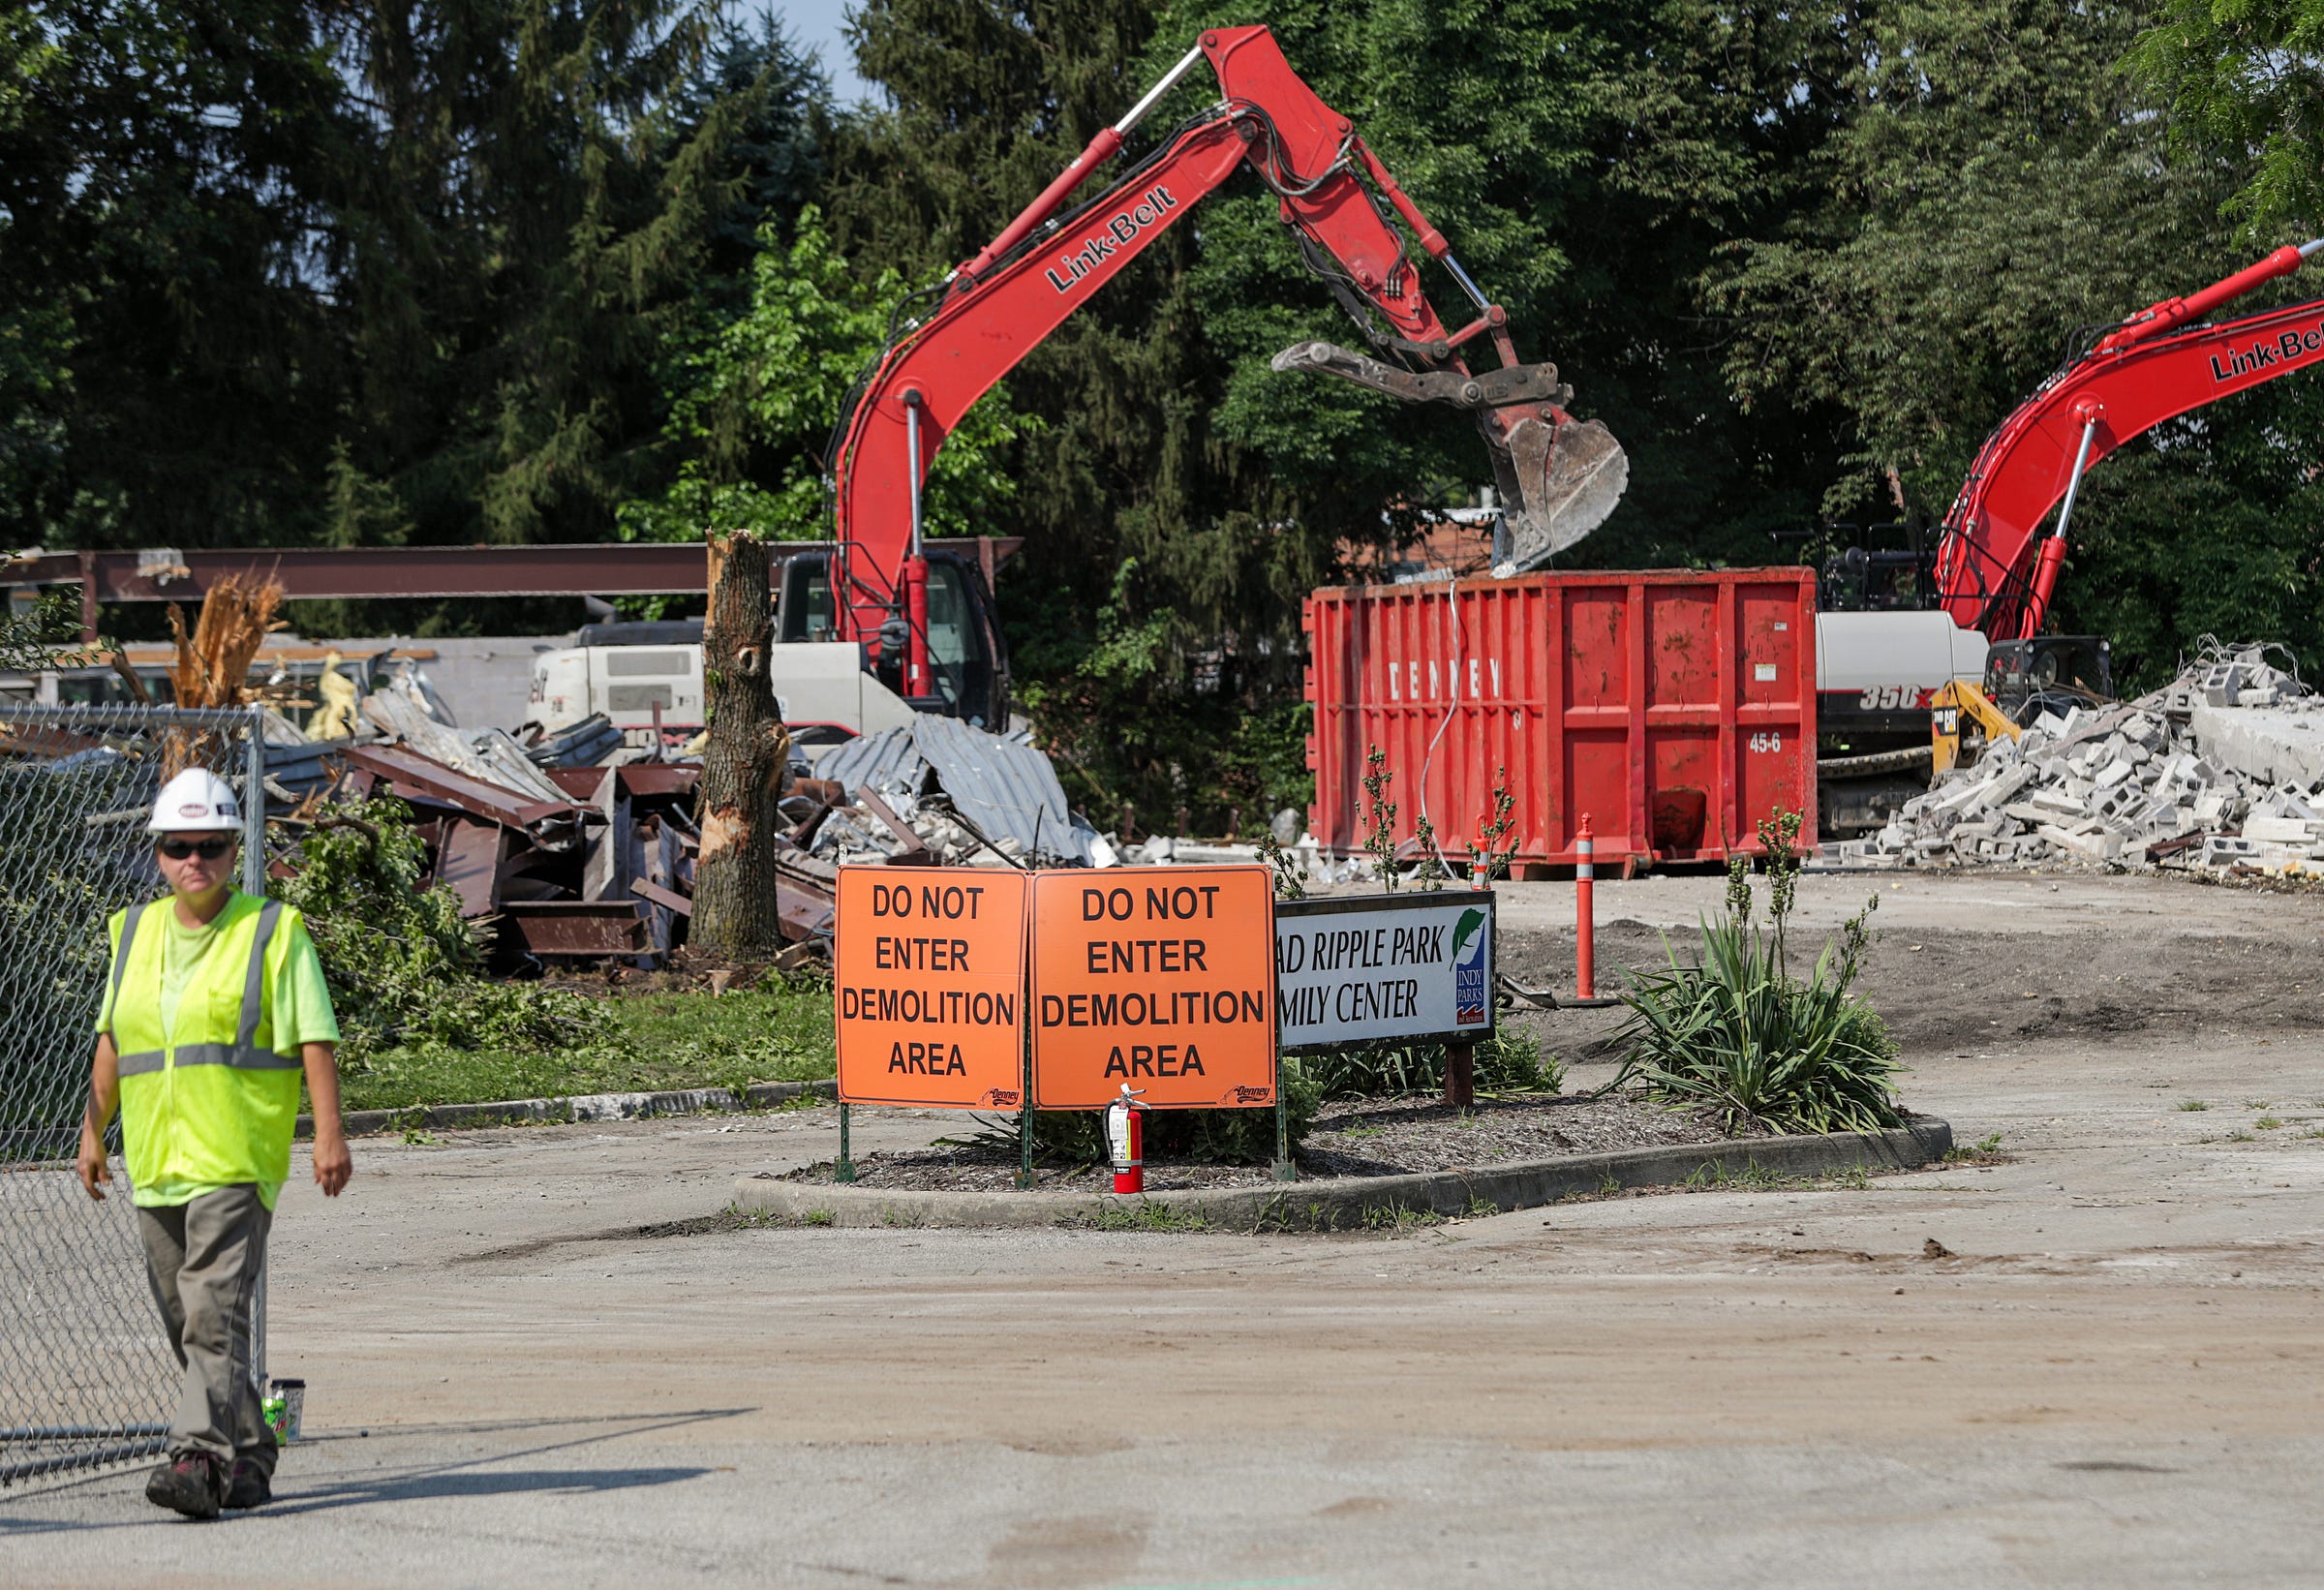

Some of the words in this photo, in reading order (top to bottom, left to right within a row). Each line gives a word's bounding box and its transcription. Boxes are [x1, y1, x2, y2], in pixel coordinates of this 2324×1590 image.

[1045, 184, 1177, 293] Link-Belt
[1750, 732, 1781, 753] 45-6
[873, 885, 912, 917] DO
[922, 886, 984, 919] NOT
[1083, 888, 1134, 921] DO
[1147, 886, 1219, 920] NOT
[876, 936, 969, 971] ENTER
[1087, 939, 1208, 974] ENTER
[1311, 929, 1387, 971] RIPPLE
[1391, 925, 1446, 966] PARK
[1457, 969, 1483, 987] INDY
[1457, 988, 1483, 1003] PARKS
[842, 987, 1014, 1026] DEMOLITION
[1041, 990, 1264, 1027] DEMOLITION
[1335, 979, 1418, 1024] CENTER
[888, 1042, 966, 1077] AREA
[1104, 1044, 1206, 1079] AREA
[992, 1087, 1020, 1104] Denney
[1237, 1085, 1270, 1101] Denney
